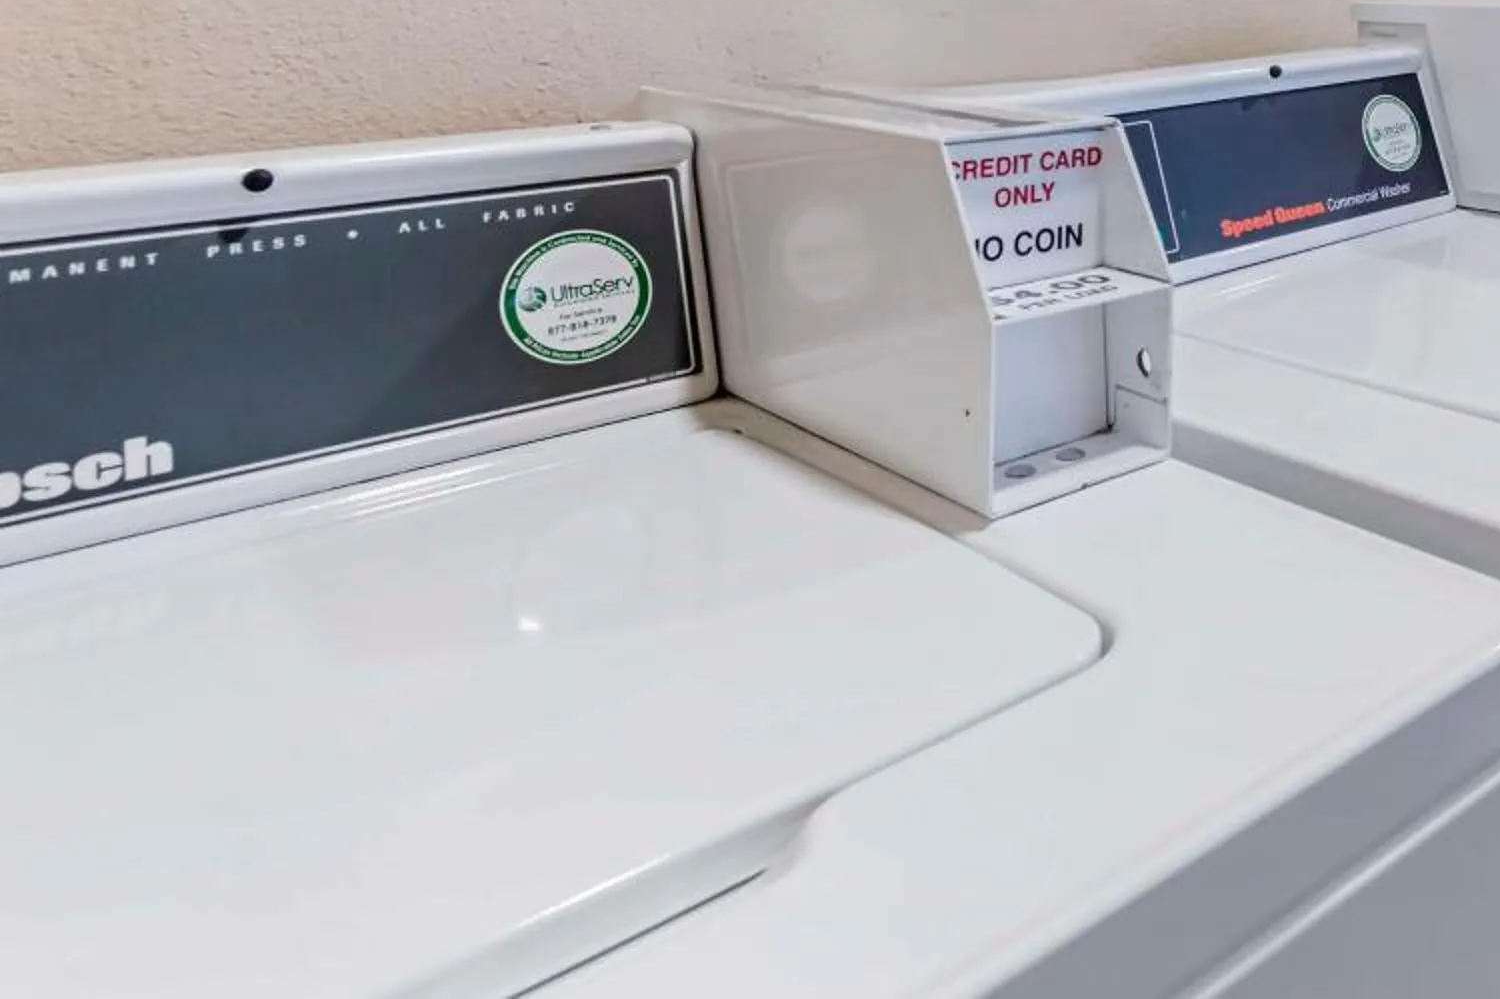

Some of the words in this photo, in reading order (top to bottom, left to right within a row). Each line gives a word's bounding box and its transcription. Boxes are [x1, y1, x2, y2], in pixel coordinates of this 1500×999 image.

[1039, 146, 1103, 172] CARD
[994, 181, 1056, 208] ONLY
[1219, 209, 1274, 238] Speed
[1274, 201, 1326, 223] Queen
[8, 252, 160, 284] MANENT
[206, 234, 308, 258] PRESS
[398, 218, 447, 233] ALL
[482, 201, 576, 223] FABRIC
[1014, 221, 1084, 257] COIN
[549, 276, 635, 302] UltraServ
